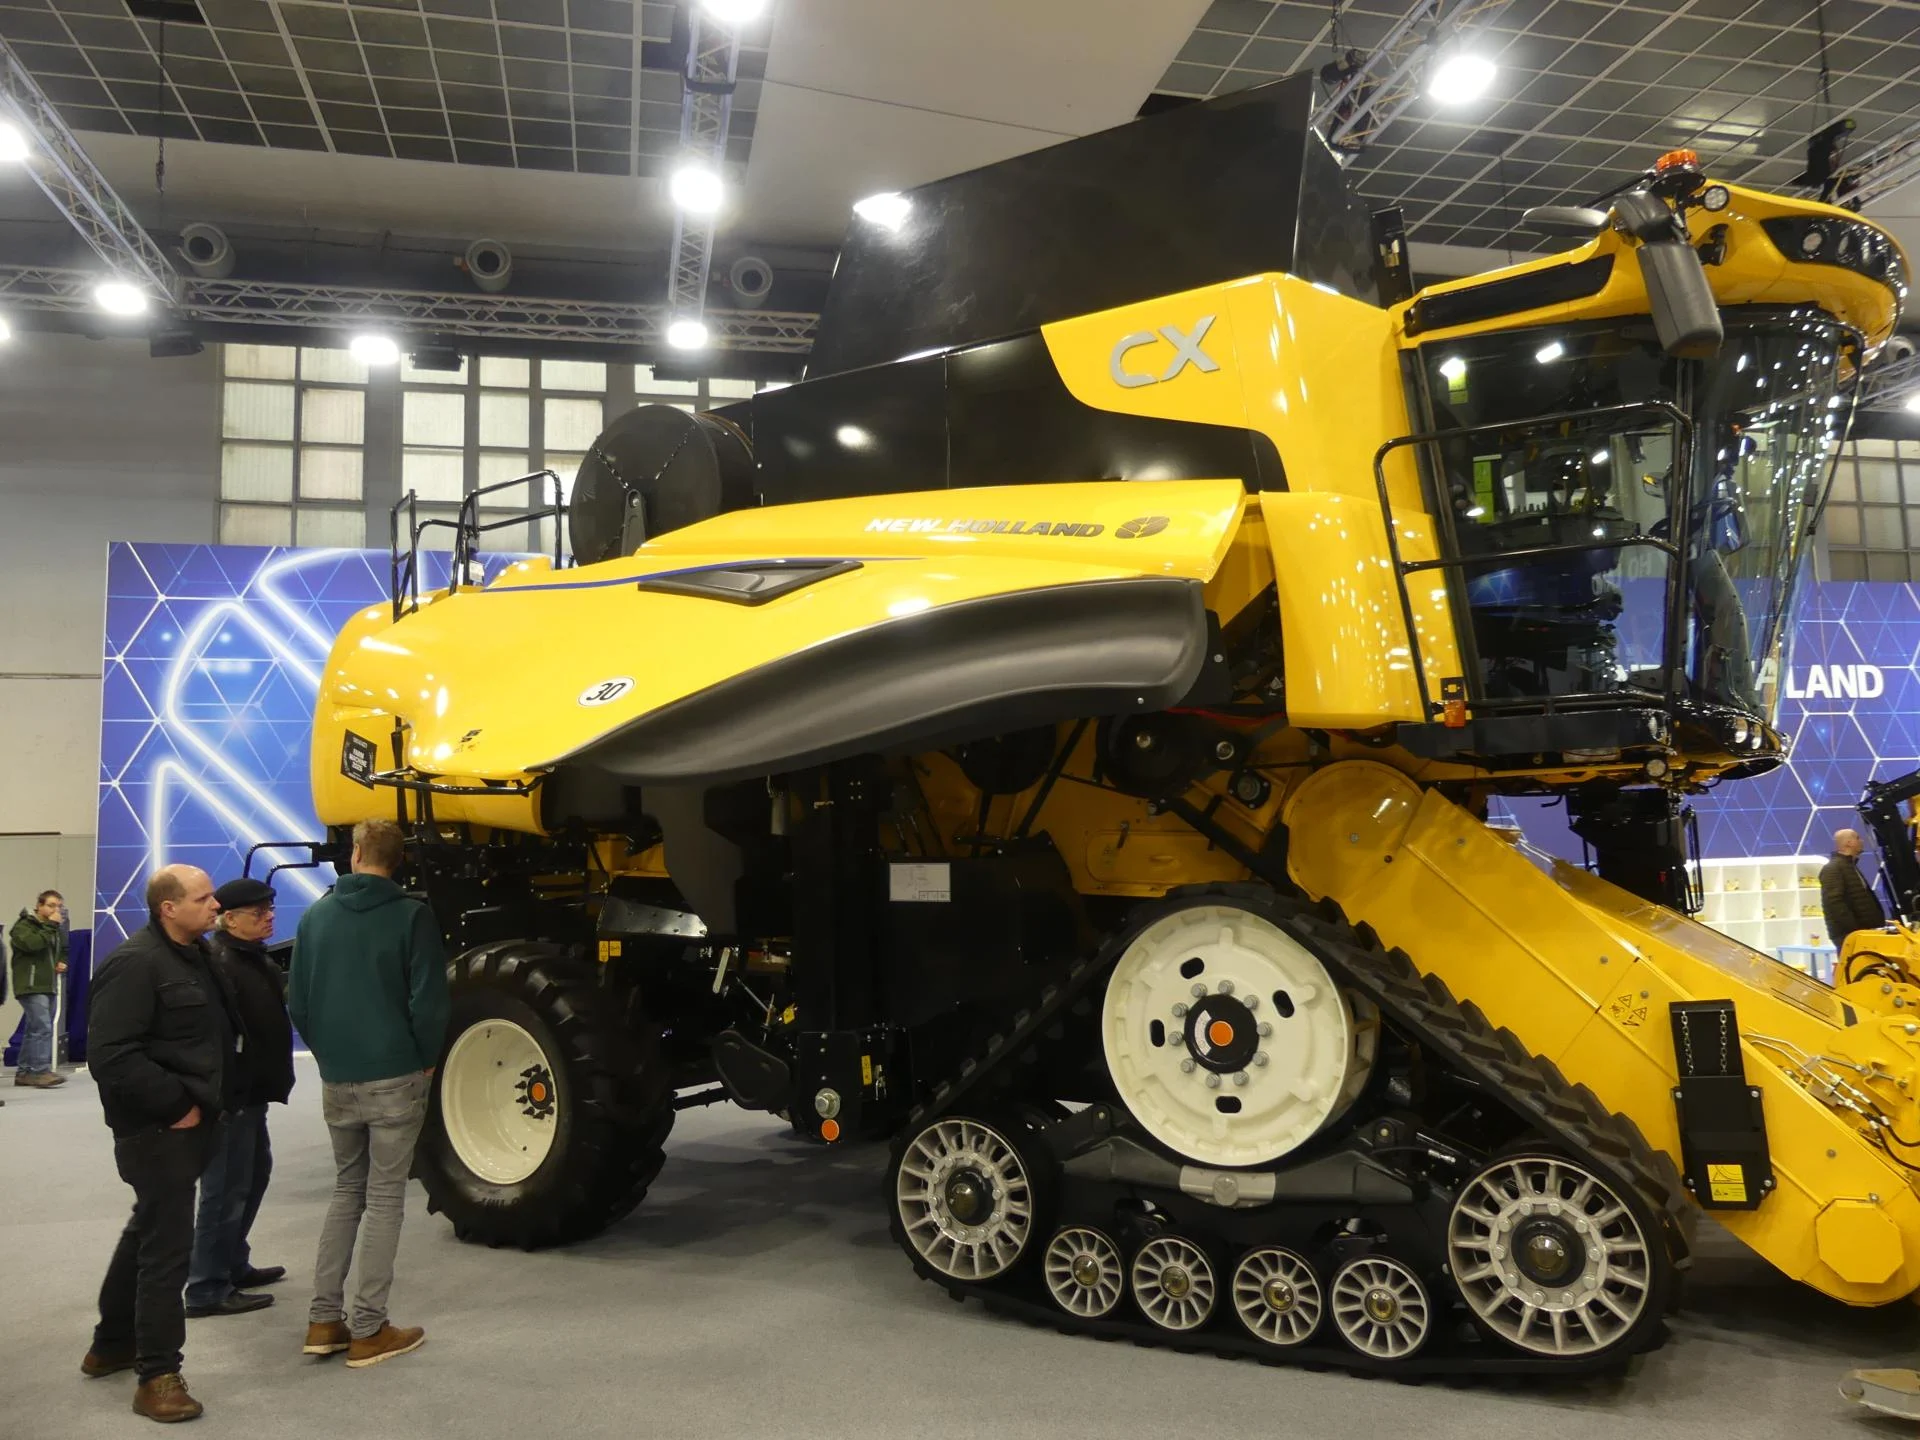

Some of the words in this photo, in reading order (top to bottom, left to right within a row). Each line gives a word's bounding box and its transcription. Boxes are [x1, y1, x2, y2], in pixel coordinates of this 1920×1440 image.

[1110, 314, 1220, 389] CX
[864, 517, 942, 534] NEW
[945, 518, 1105, 538] HOLLAND
[586, 682, 627, 701] 30
